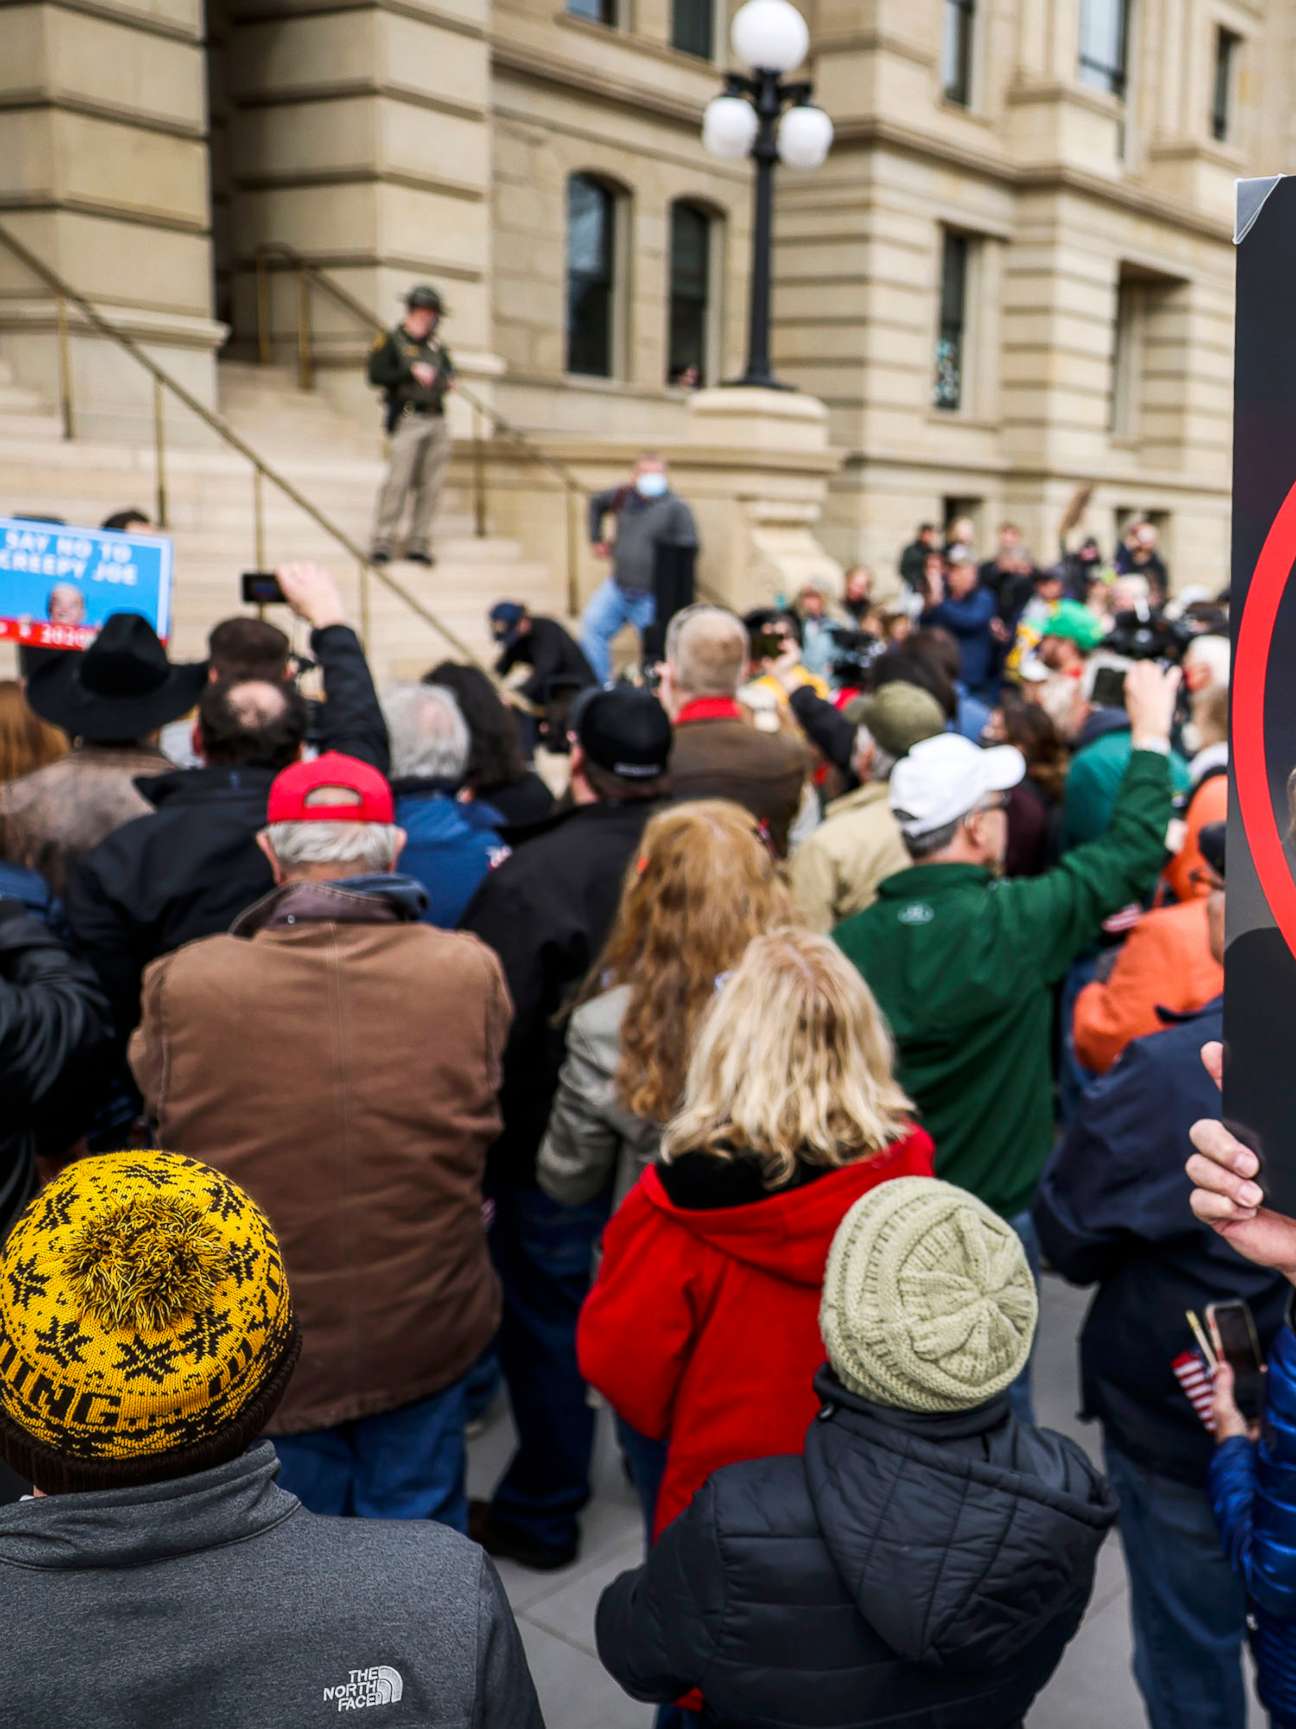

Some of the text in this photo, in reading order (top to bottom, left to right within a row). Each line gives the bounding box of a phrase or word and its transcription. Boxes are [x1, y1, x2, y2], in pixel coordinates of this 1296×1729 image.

[5, 530, 132, 563] SAY NO TO
[92, 561, 138, 586] JOE
[348, 1666, 379, 1683] THE
[323, 1680, 377, 1701] NORTH
[338, 1693, 376, 1712] FACE
